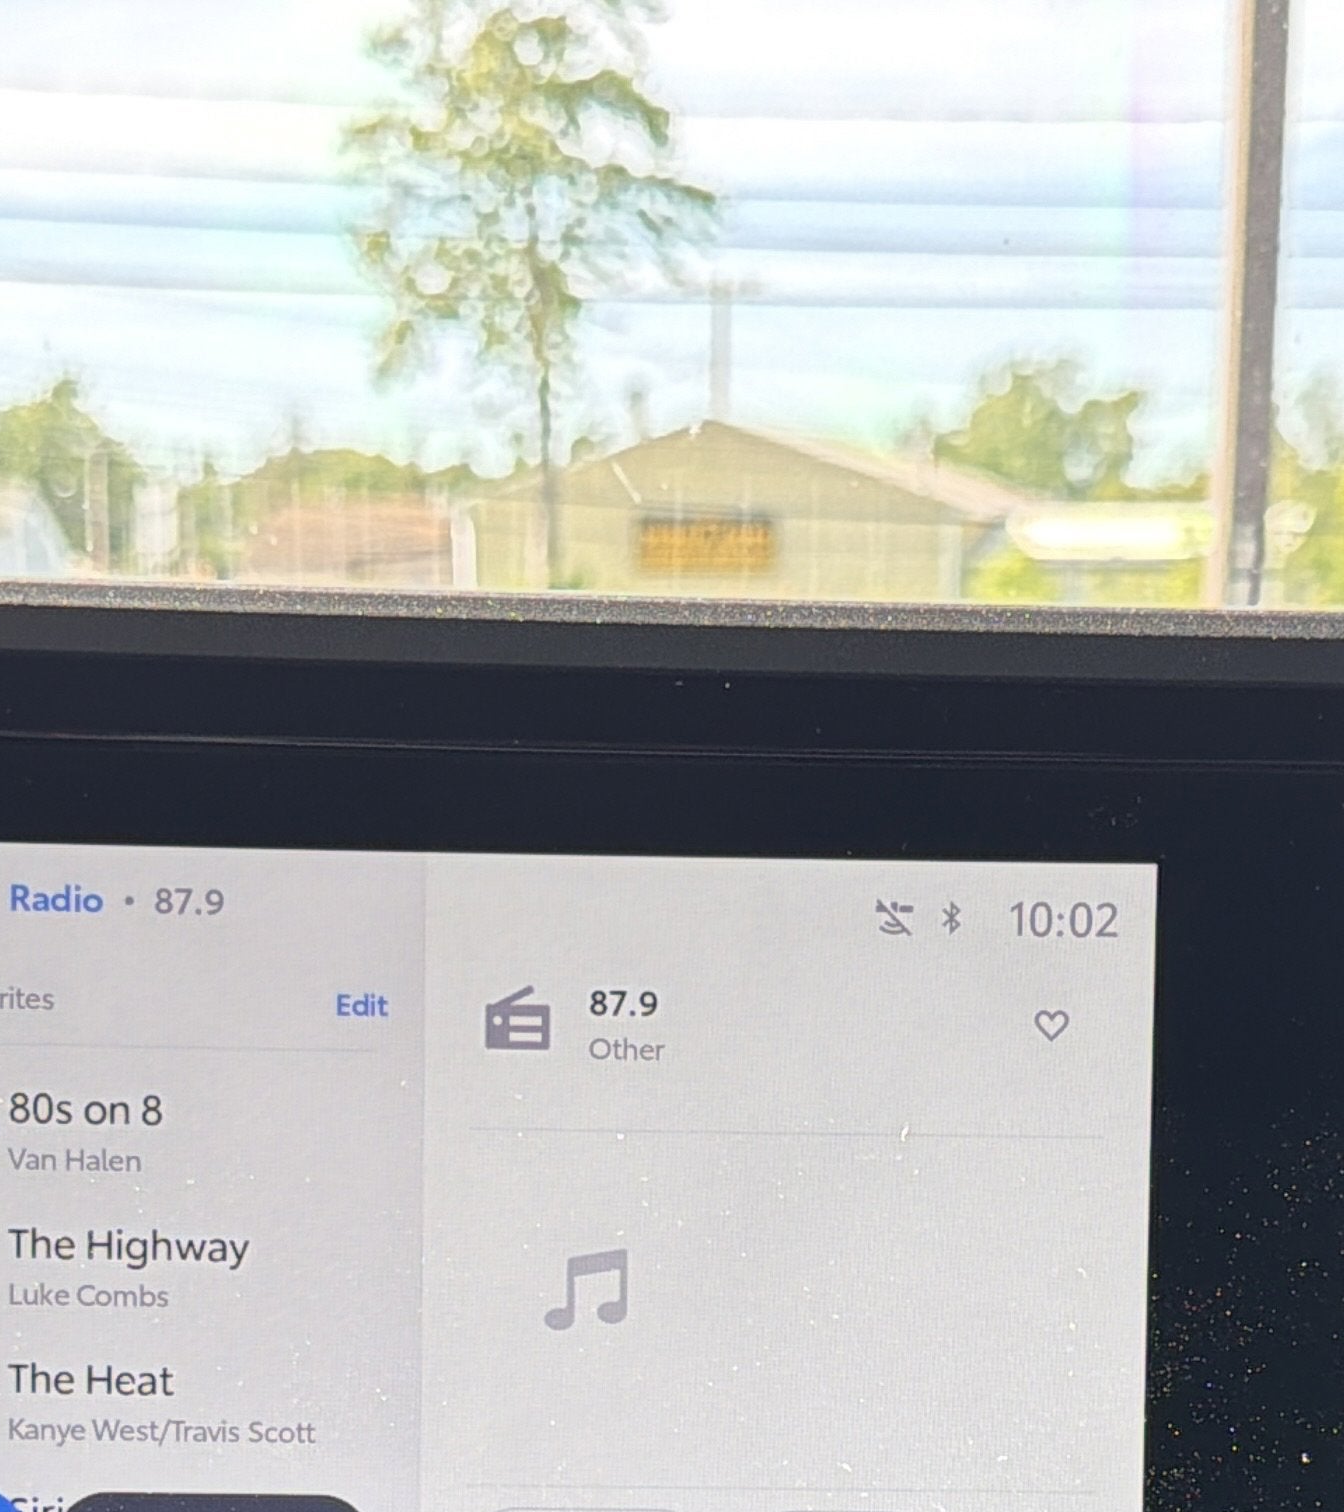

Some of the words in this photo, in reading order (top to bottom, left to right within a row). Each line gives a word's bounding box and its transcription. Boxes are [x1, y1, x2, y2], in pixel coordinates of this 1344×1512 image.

[10, 883, 104, 913] Radio
[154, 887, 225, 916] 87.9
[1010, 901, 1119, 938] 10:02
[336, 993, 388, 1017] Edit
[589, 990, 658, 1018] 87.9
[588, 1037, 665, 1062] Other
[9, 1092, 73, 1126] 80s
[85, 1101, 130, 1126] on
[141, 1094, 163, 1127] 8
[8, 1147, 56, 1171] Van
[65, 1148, 142, 1172] Halen
[8, 1227, 76, 1261] The
[87, 1228, 250, 1271] Highway
[9, 1282, 70, 1307] Luke
[77, 1284, 169, 1308] Combs
[8, 1362, 75, 1395] The
[87, 1364, 174, 1397] Heat
[8, 1417, 86, 1447] Kanye
[91, 1418, 240, 1446] West/Travis
[248, 1420, 316, 1445] Scott
